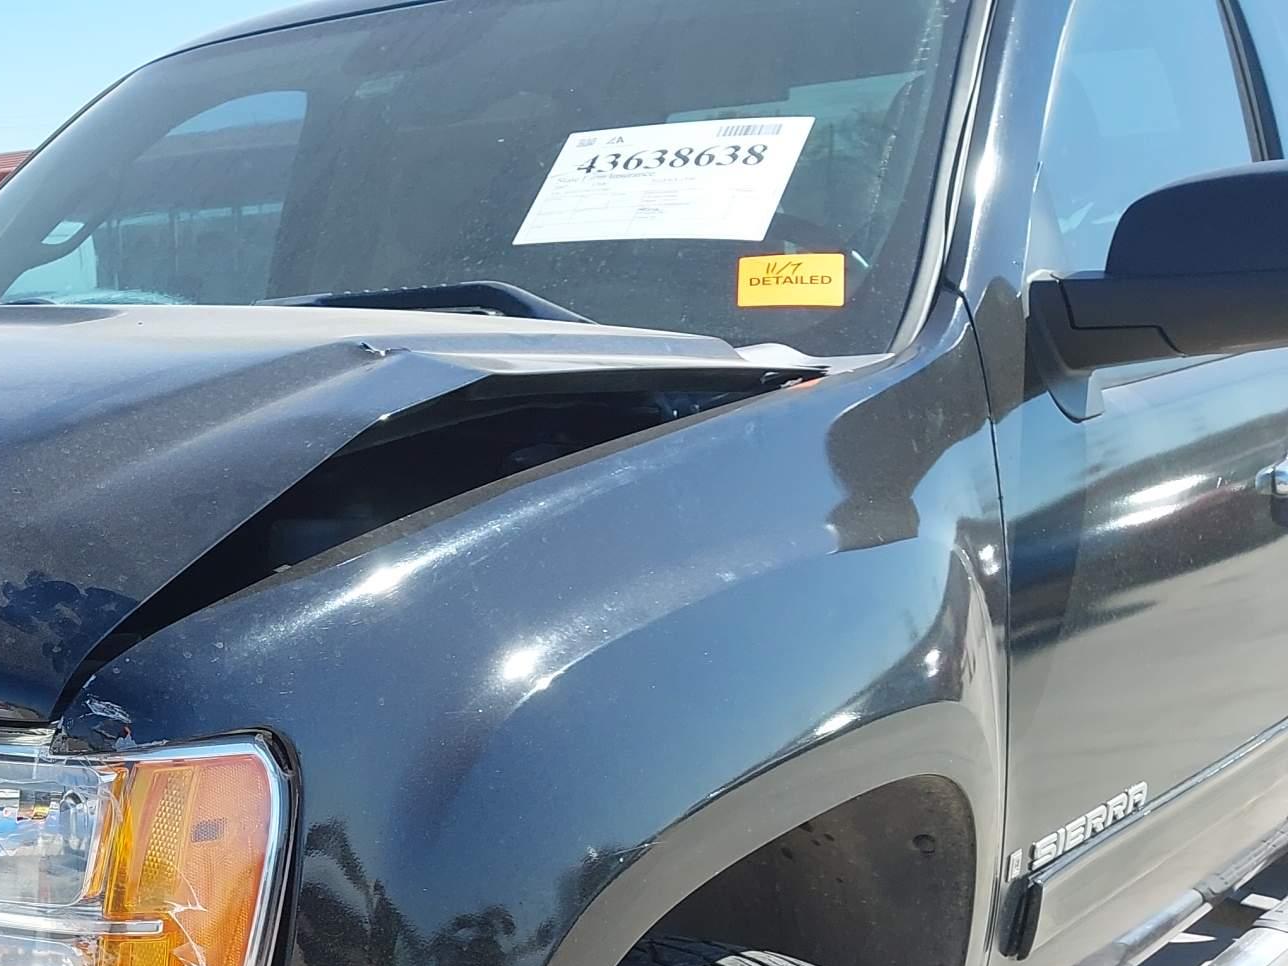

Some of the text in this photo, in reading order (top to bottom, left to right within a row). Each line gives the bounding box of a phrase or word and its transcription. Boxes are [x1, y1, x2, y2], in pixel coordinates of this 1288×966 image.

[576, 143, 768, 173] 43638638
[766, 261, 803, 275] 11/7
[749, 275, 832, 287] DETAILED
[1029, 780, 1149, 871] SIERRA
